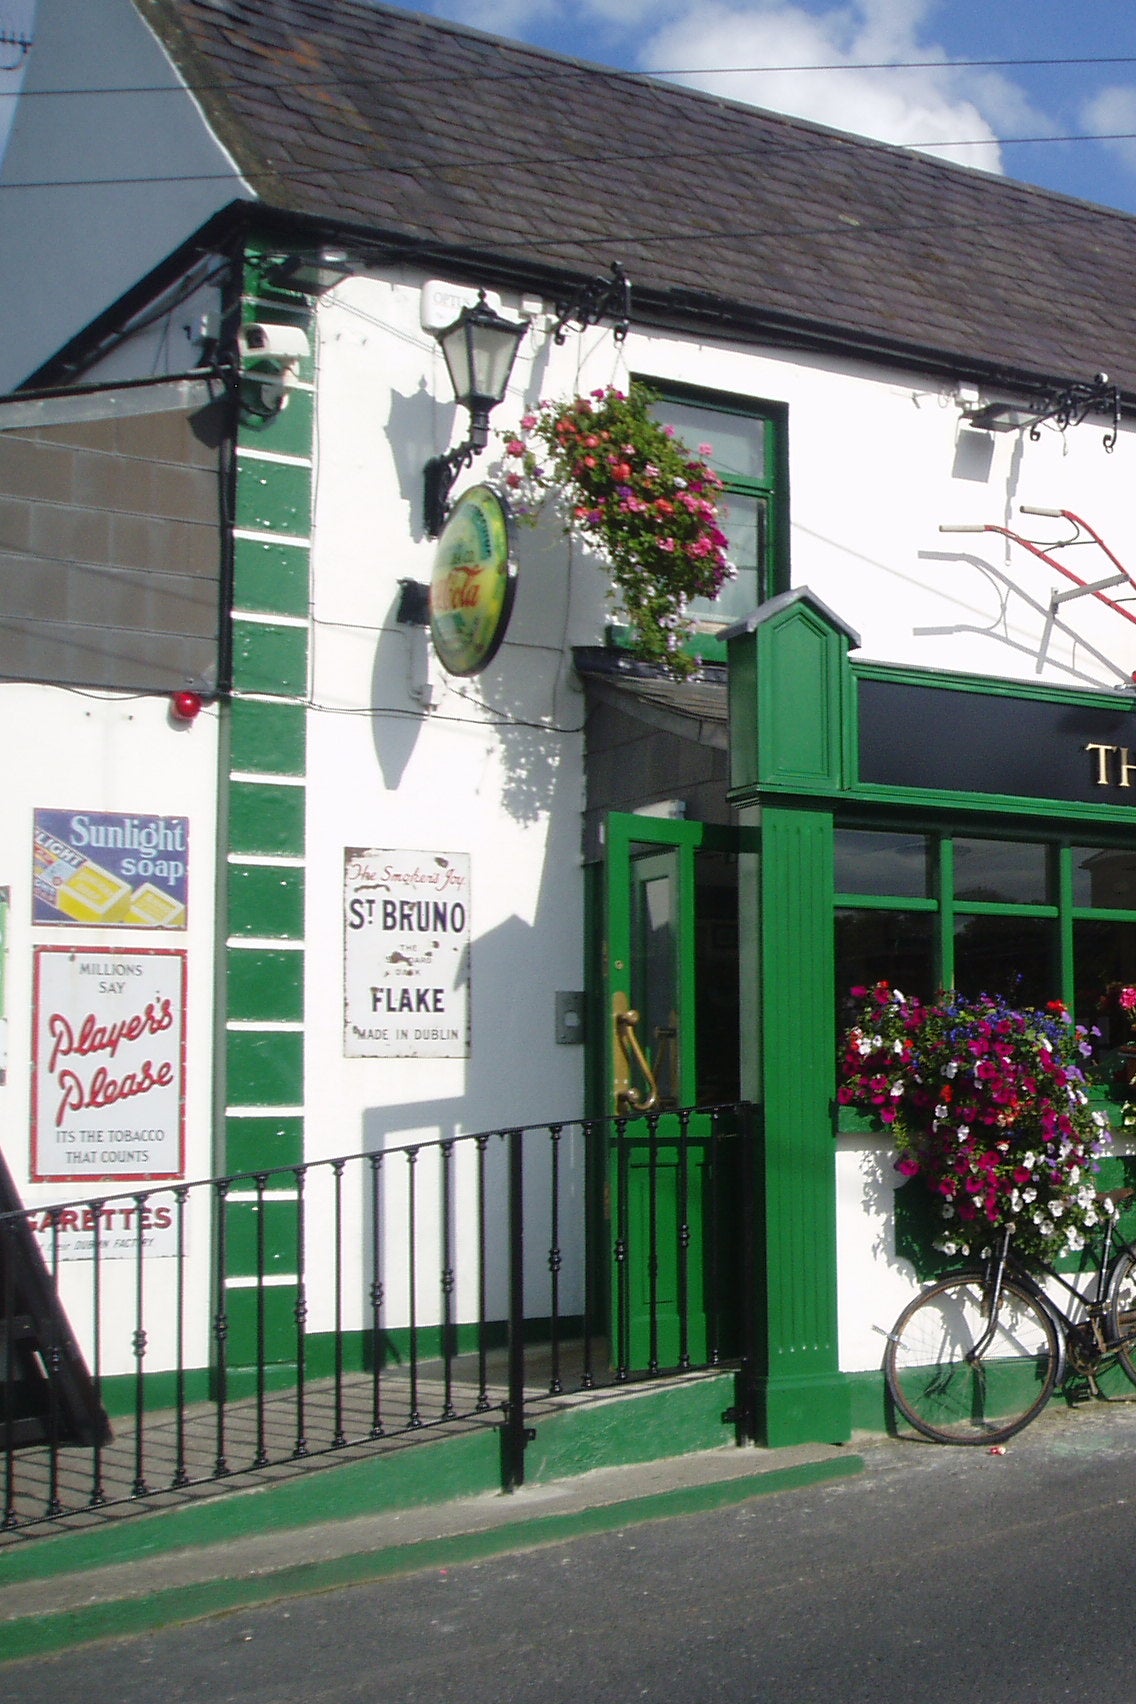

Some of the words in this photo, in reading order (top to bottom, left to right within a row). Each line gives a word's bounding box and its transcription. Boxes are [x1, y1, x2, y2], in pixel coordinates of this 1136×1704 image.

[70, 815, 186, 858] Sunlight
[120, 858, 185, 886] soap
[348, 863, 377, 881] The
[382, 899, 466, 933] BRUNO
[79, 963, 143, 976] MILLIONS
[98, 981, 126, 994] SAY
[370, 987, 446, 1013] FLAKE
[355, 1027, 389, 1040] MADE
[396, 1028, 408, 1040] IN
[414, 1028, 459, 1041] DUBLIN
[55, 1060, 174, 1127] Please
[79, 1129, 105, 1143] THE
[107, 1129, 166, 1142] TOBACCO
[65, 1150, 98, 1164] THAT
[100, 1149, 150, 1163] COUNTS
